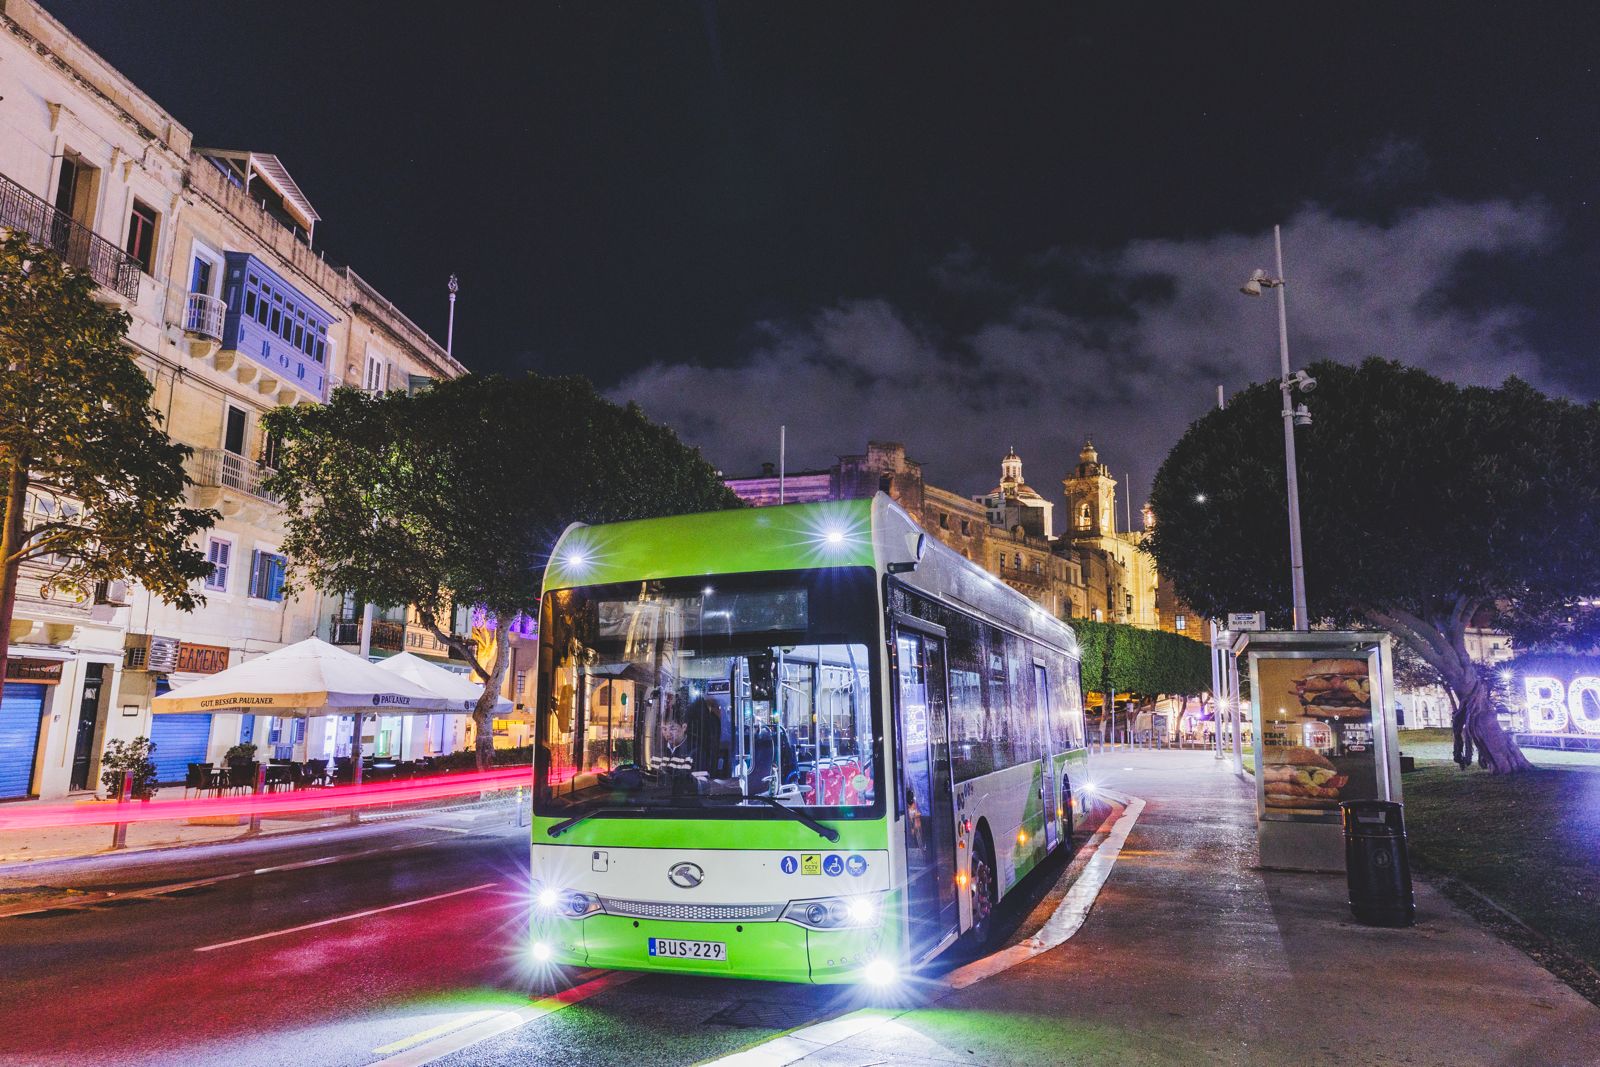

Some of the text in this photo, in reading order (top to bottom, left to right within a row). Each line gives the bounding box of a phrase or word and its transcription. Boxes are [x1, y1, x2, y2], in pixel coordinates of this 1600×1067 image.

[178, 647, 225, 672] EAMENS
[380, 695, 411, 705] PAULANER
[658, 940, 721, 958] BUS 229
